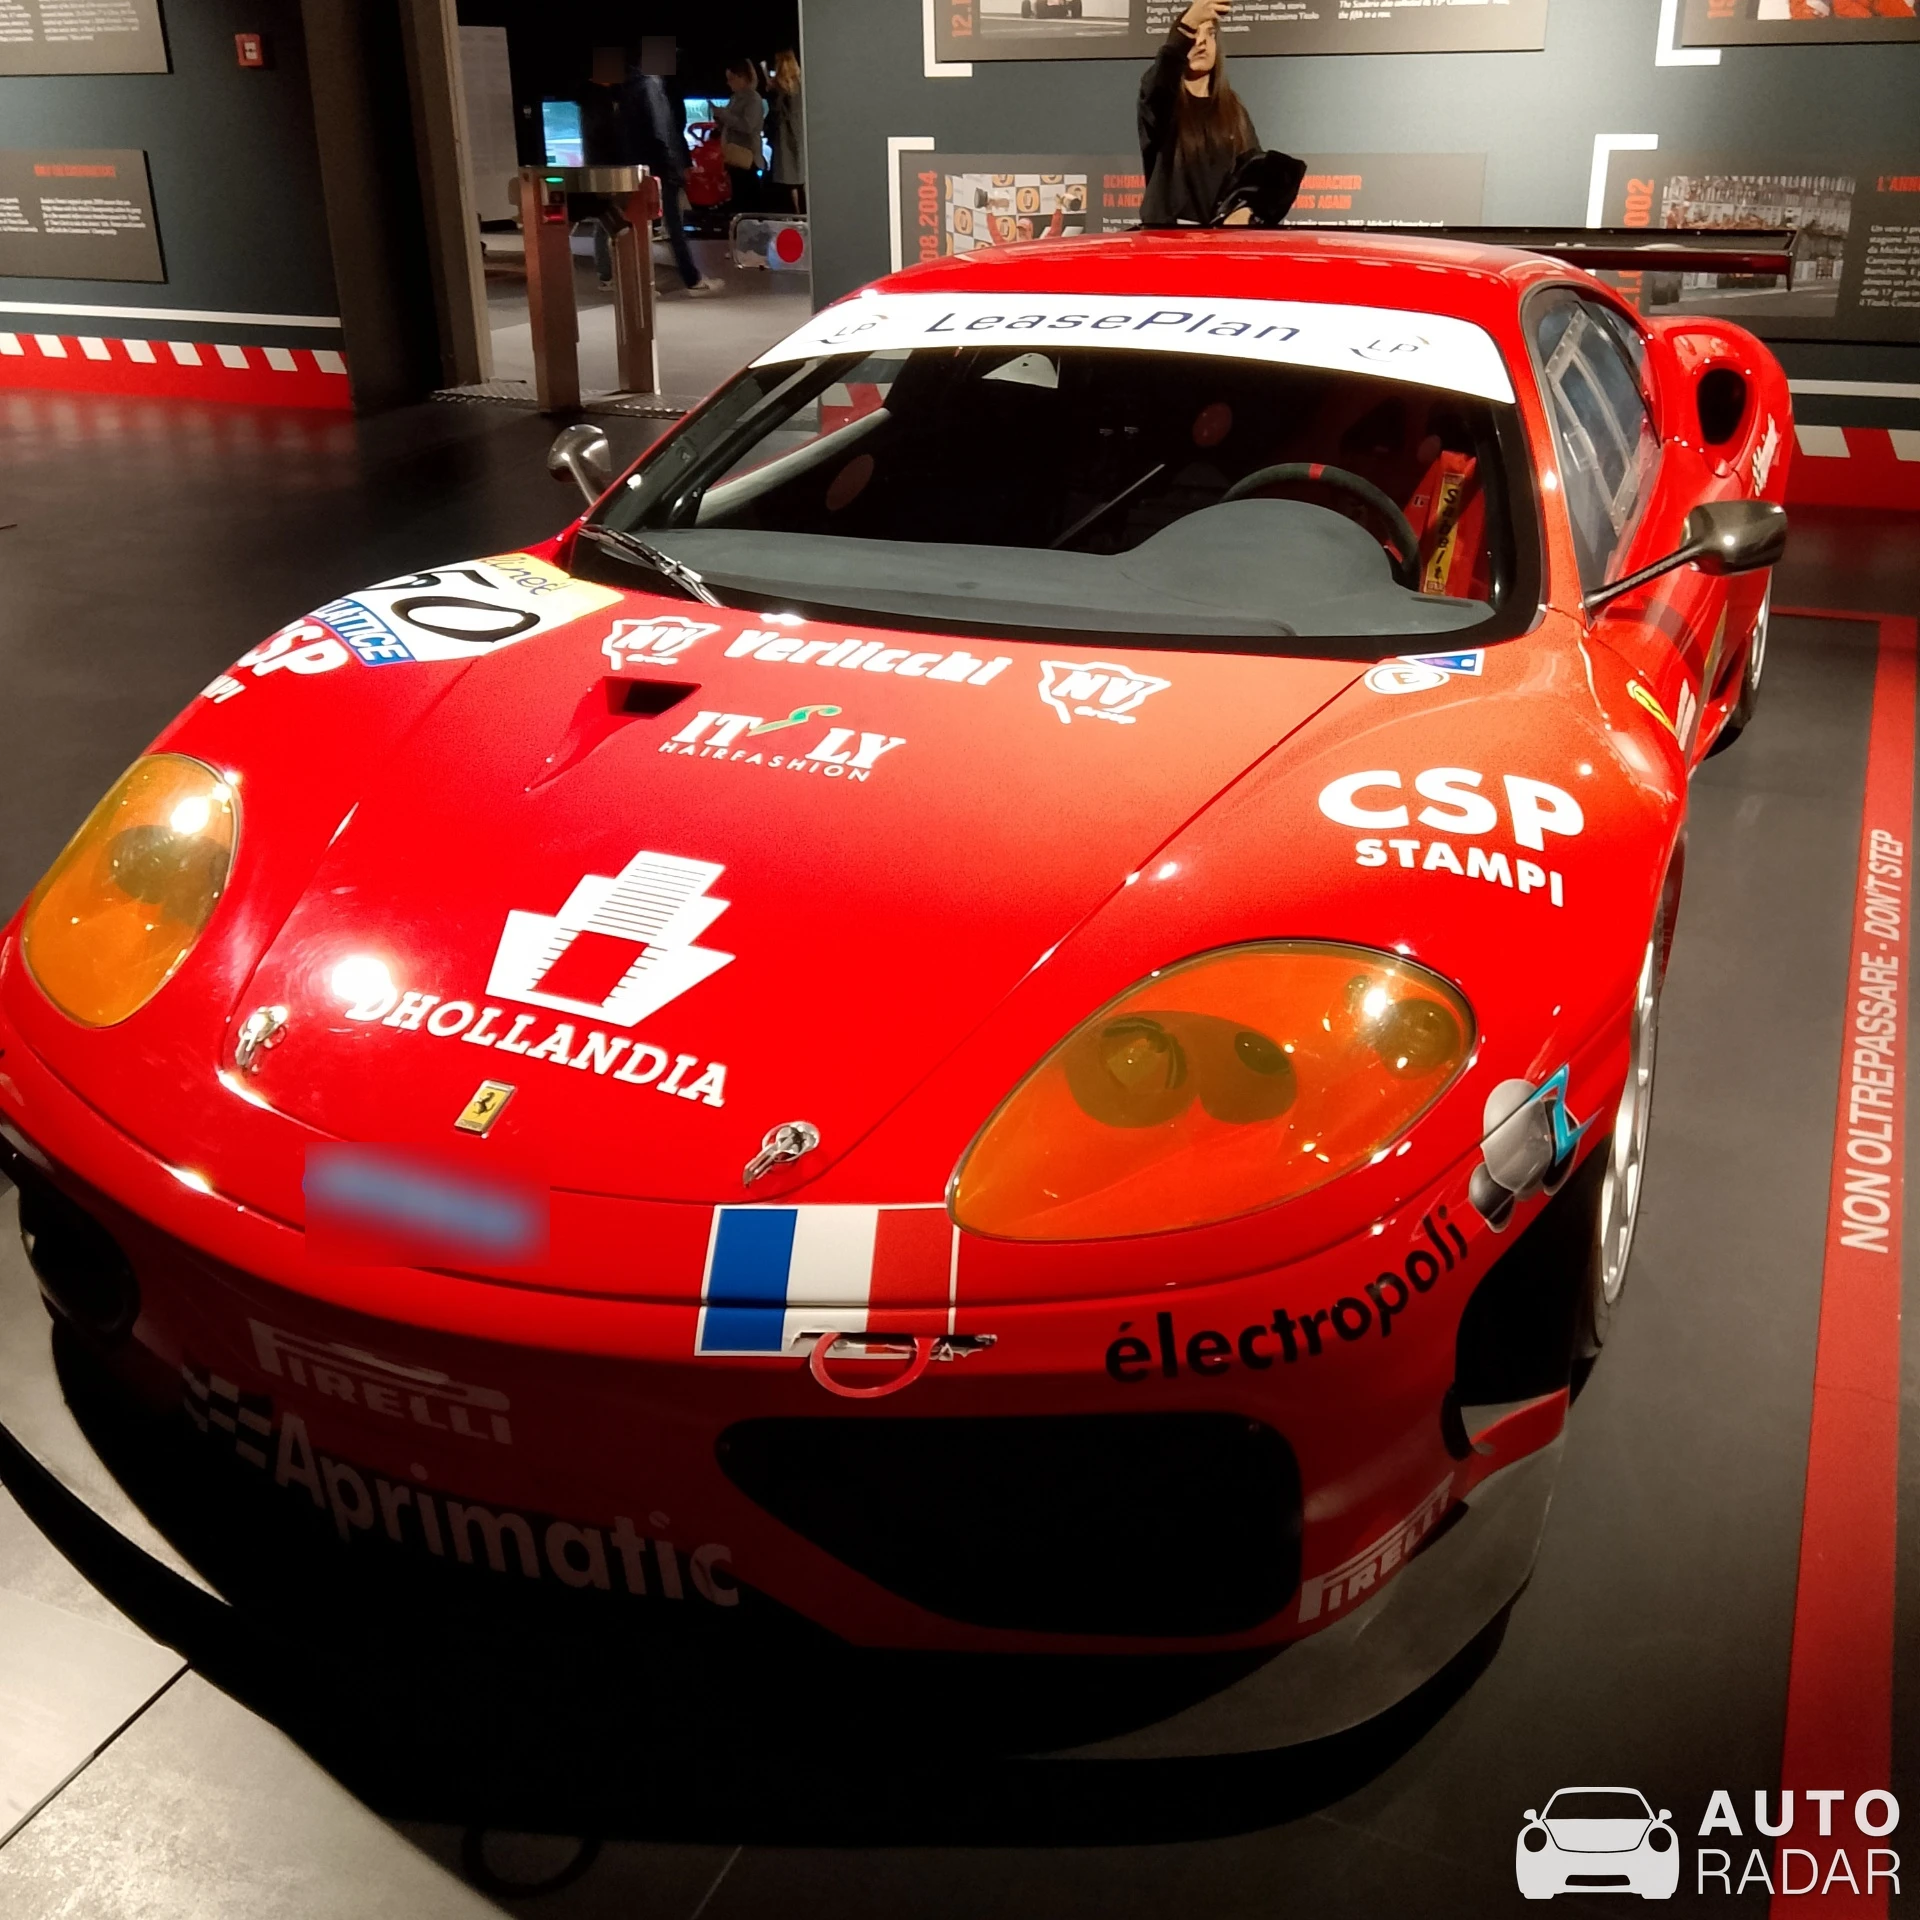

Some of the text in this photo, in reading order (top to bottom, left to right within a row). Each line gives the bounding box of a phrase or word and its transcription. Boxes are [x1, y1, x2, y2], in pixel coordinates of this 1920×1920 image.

[1103, 174, 1145, 189] SCHUMA
[1116, 193, 1143, 208] ANC
[924, 310, 1301, 342] LeasePlan
[723, 629, 1014, 686] Verlicchi
[657, 741, 872, 783] HAIRFASHION
[1317, 766, 1585, 852] CSP
[1355, 838, 1565, 908] STAMPI
[1867, 828, 1904, 879] STEP
[1863, 873, 1902, 941] DON'T
[344, 990, 729, 1108] DHOLLANDIA
[1846, 950, 1900, 1166] OLTREPASSARE
[1840, 1167, 1892, 1254] NON
[1105, 1204, 1469, 1383] électropoli
[246, 1316, 513, 1446] PIRELLI
[275, 1411, 740, 1607] Aprimatic
[1297, 1470, 1455, 1624] PIRELLI
